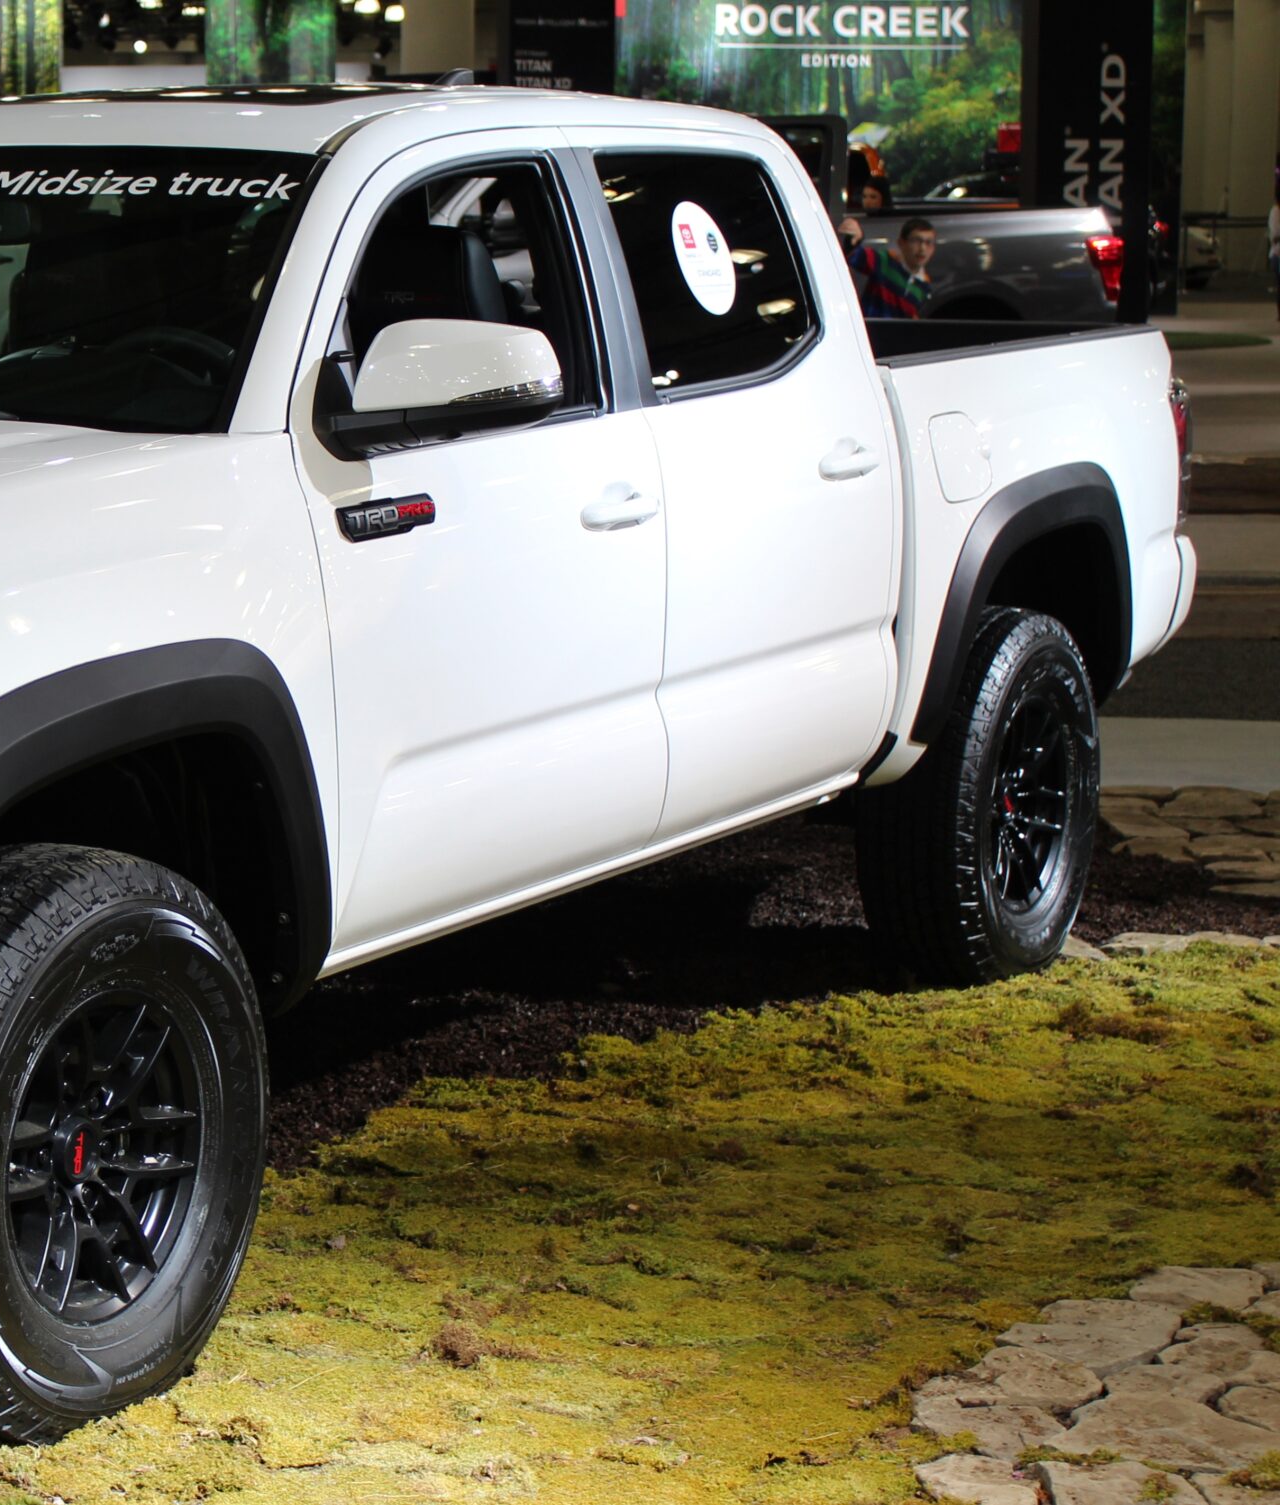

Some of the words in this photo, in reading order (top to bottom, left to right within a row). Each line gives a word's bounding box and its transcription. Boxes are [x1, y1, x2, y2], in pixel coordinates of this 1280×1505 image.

[714, 4, 821, 37] ROCK
[832, 5, 969, 37] CREEK
[515, 59, 553, 72] TITAN
[801, 53, 870, 68] EDITION
[1099, 54, 1127, 125] XD
[168, 172, 301, 200] truck
[347, 505, 399, 530] TRD
